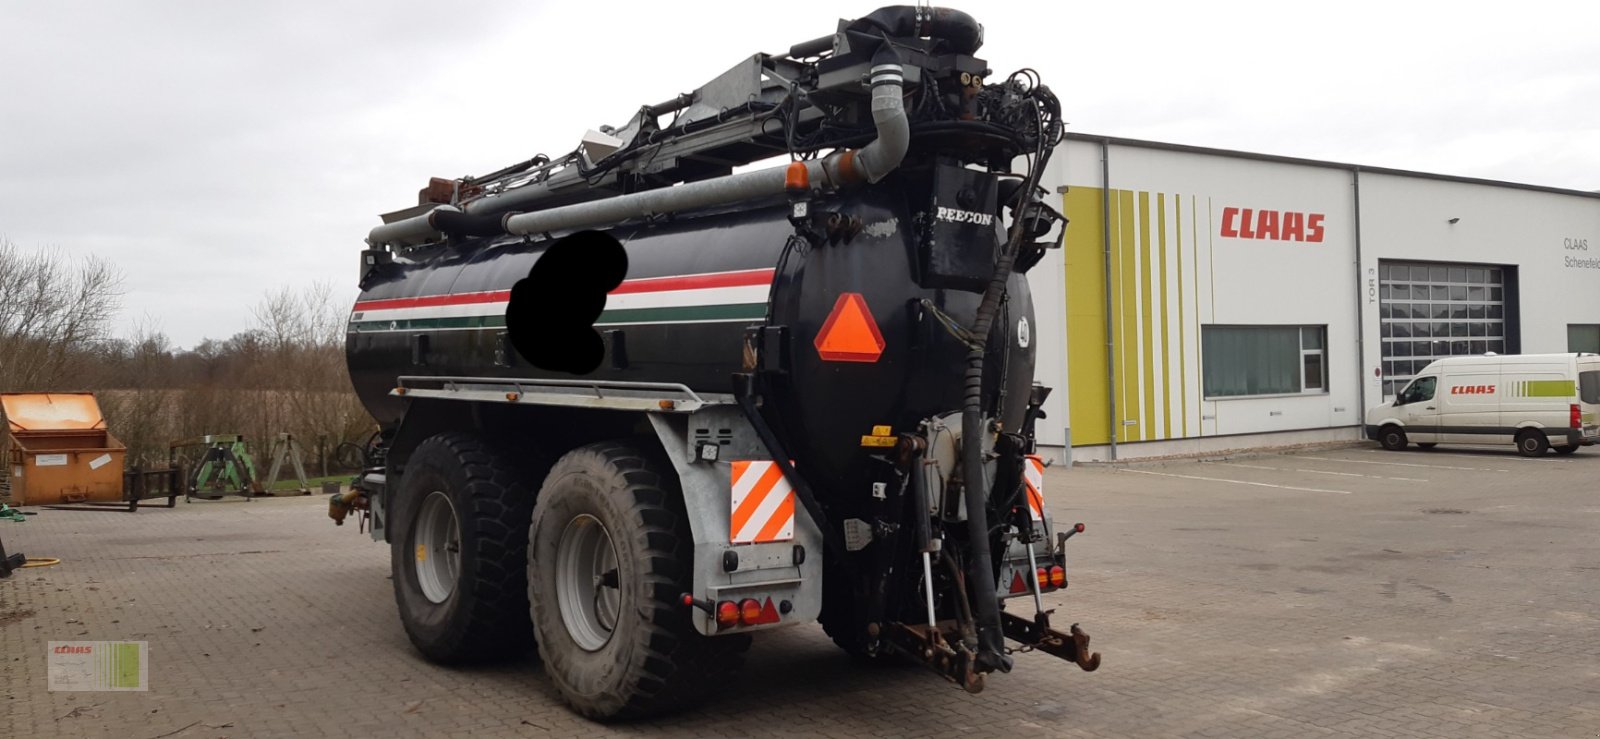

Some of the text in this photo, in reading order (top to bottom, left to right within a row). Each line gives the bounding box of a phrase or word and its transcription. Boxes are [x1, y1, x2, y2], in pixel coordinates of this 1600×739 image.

[936, 206, 993, 226] PEECON
[1220, 207, 1325, 243] CLAAS
[1563, 237, 1588, 251] CLAAS
[1368, 279, 1376, 304] TOR
[1451, 385, 1496, 394] CLAAS
